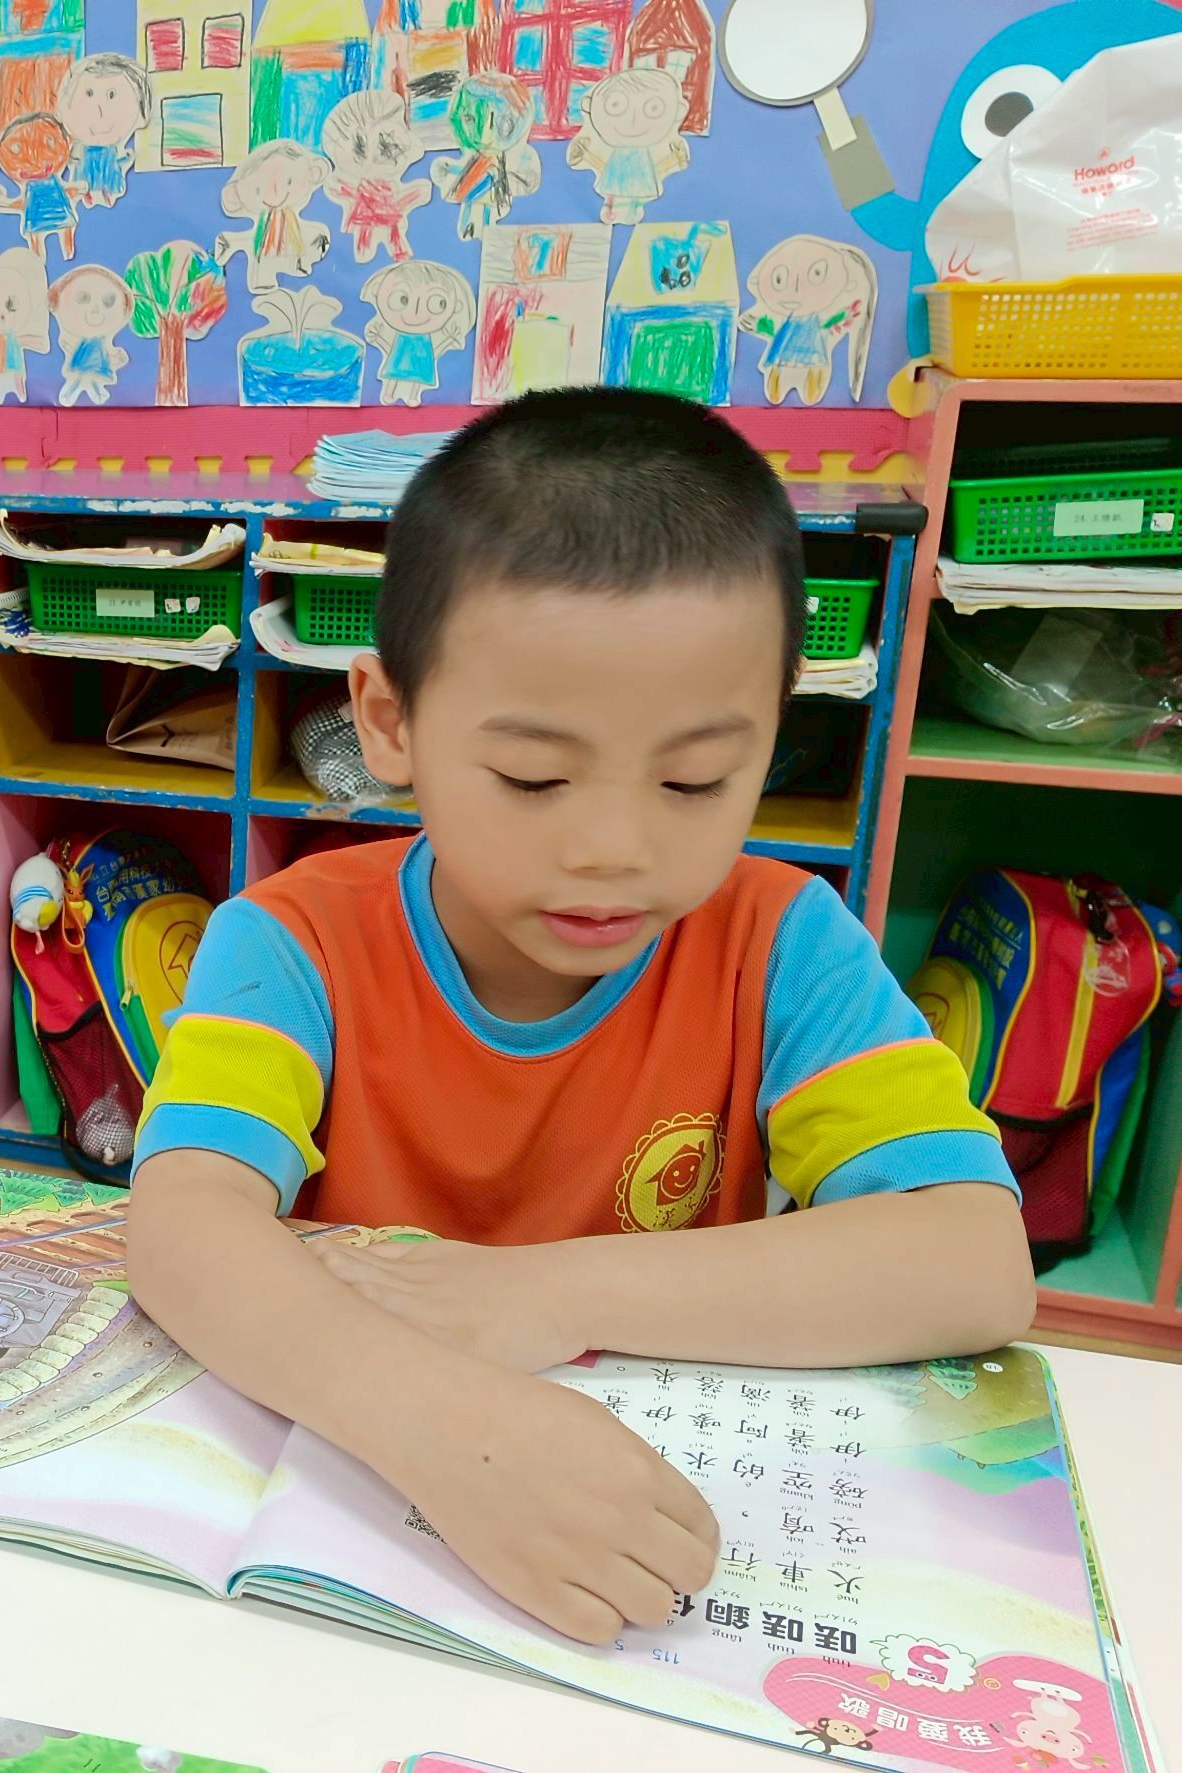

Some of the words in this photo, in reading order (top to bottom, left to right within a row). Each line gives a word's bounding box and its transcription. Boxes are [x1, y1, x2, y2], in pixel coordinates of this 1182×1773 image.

[614, 1638, 625, 1652] 5
[652, 1648, 681, 1665] 115
[907, 1645, 951, 1685] 5
[838, 1693, 993, 1747] 我愛唱歌
